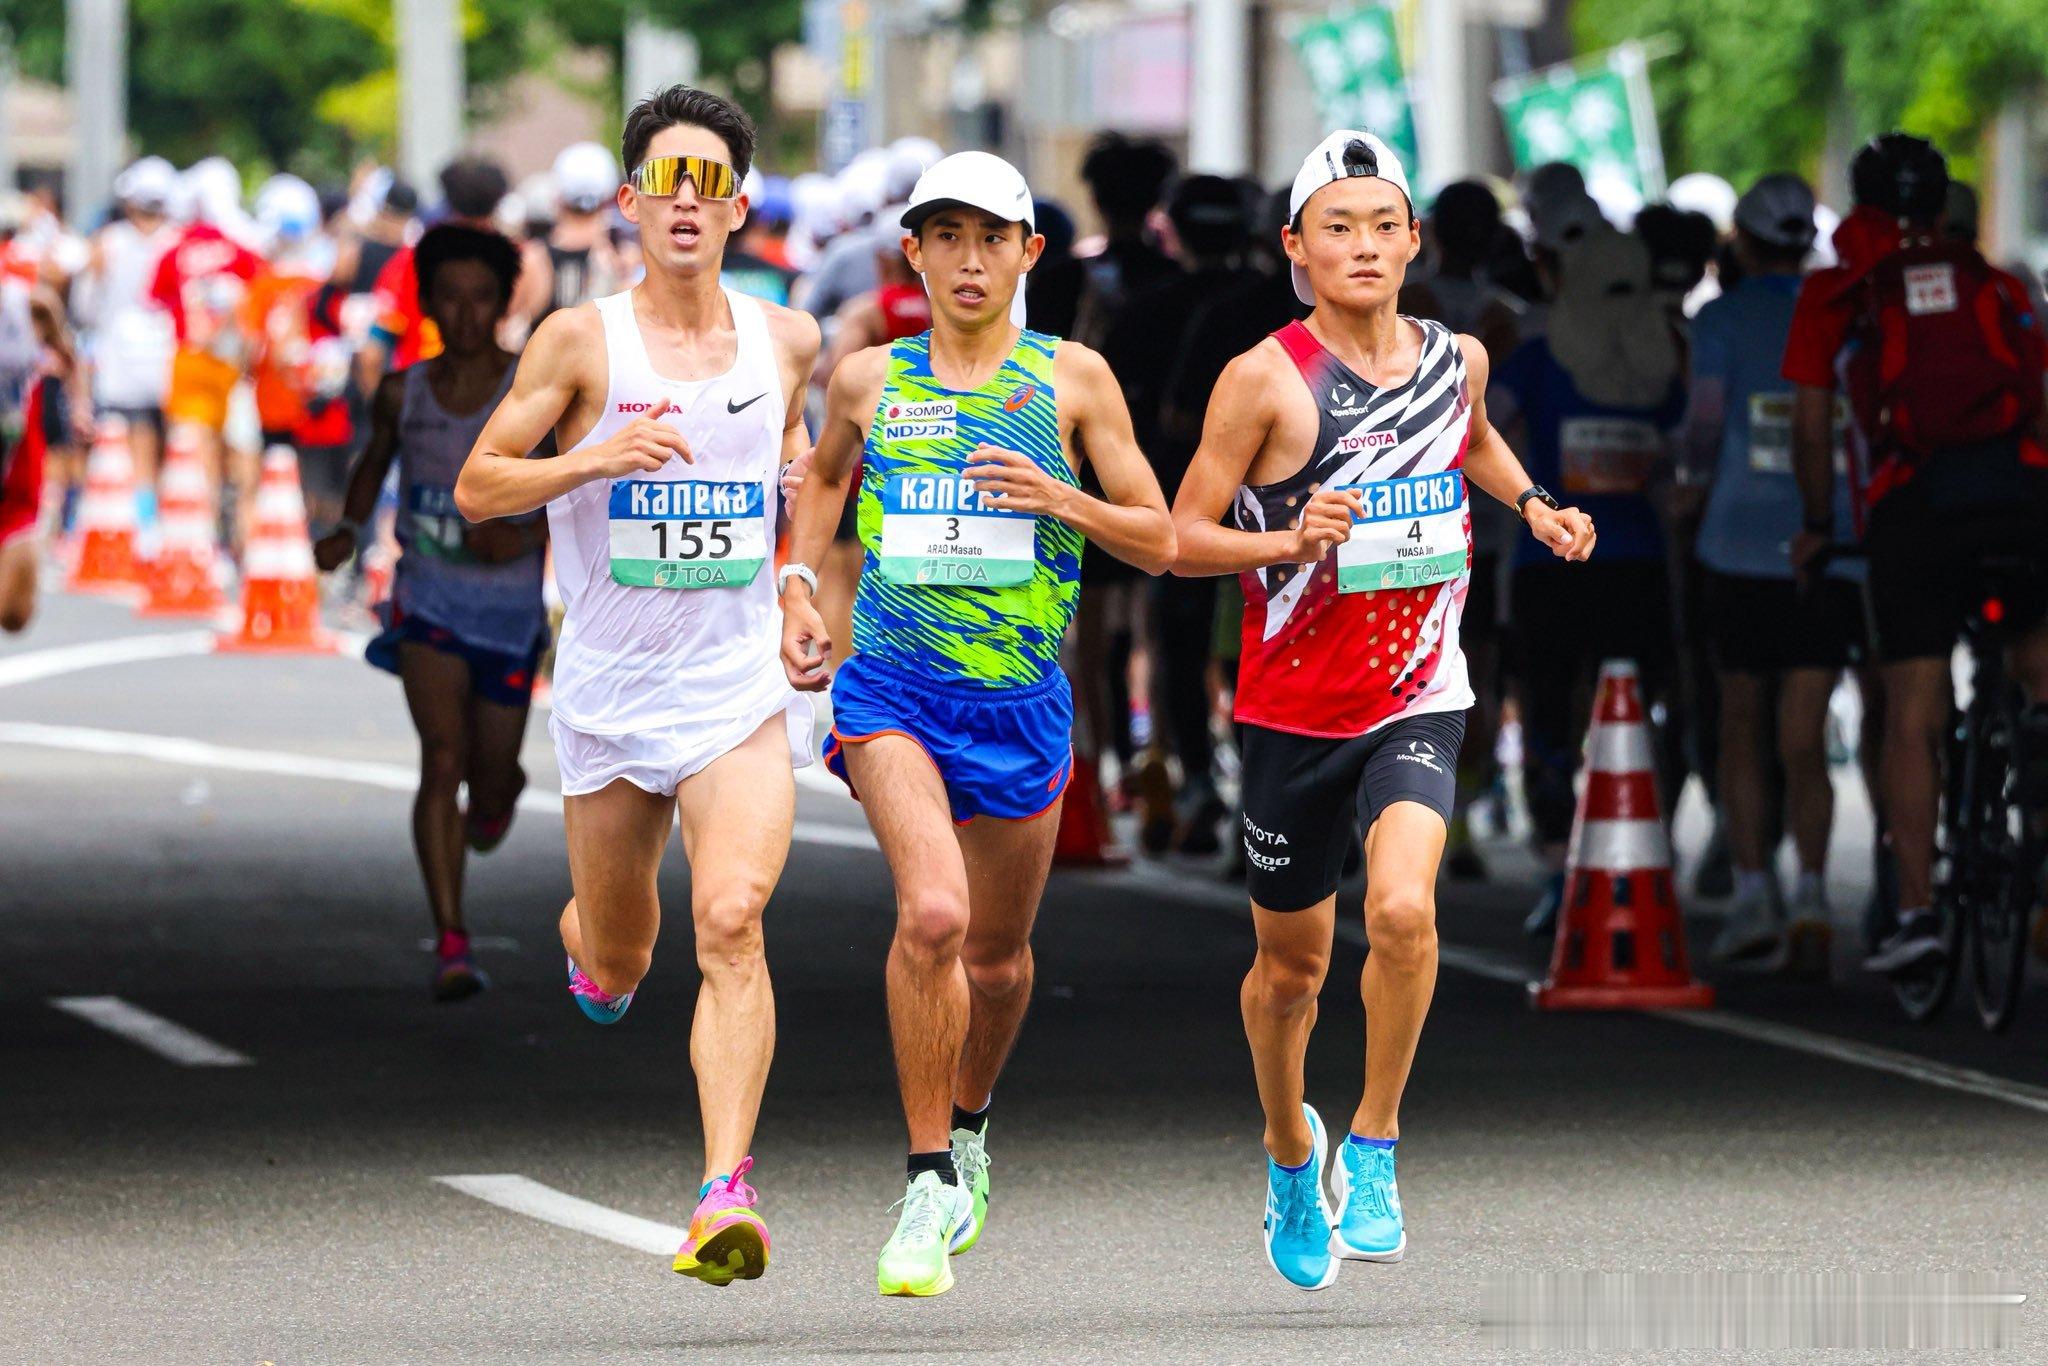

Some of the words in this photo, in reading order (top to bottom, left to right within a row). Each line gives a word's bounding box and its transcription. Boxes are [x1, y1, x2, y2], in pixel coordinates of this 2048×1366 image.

[618, 403, 683, 414] HOA
[905, 404, 953, 418] SOMPO
[886, 424, 953, 439] NDソフト
[1341, 433, 1395, 450] TOYOTA
[945, 517, 960, 541] 3
[1407, 520, 1422, 543] 4
[651, 521, 732, 560] 155
[950, 544, 983, 556] Masato
[1396, 546, 1425, 558] YUASA
[682, 567, 728, 584] TOA
[941, 563, 989, 582] TOA
[1407, 561, 1441, 583] TOA
[1242, 811, 1289, 845] TOYOTA
